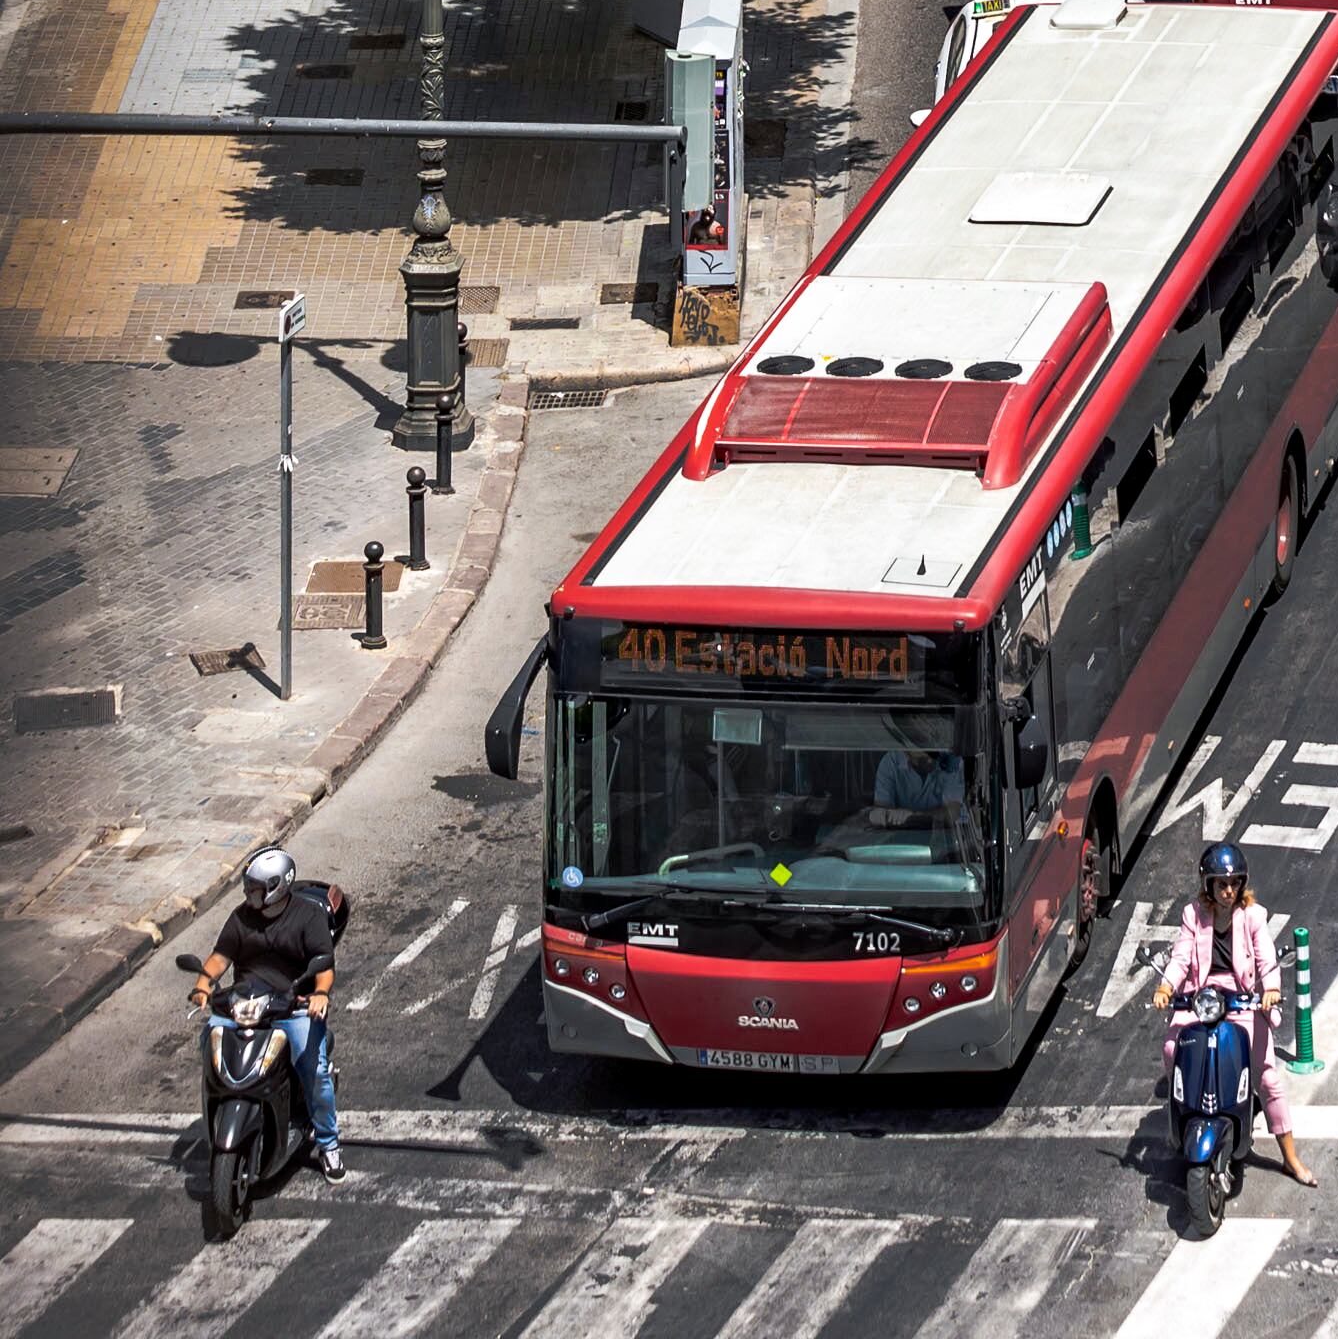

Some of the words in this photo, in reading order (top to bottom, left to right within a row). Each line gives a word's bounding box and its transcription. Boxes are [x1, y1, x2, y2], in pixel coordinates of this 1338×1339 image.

[983, 0, 1002, 12] TAXI
[1019, 546, 1044, 600] EMT
[618, 628, 666, 673] 40
[674, 631, 807, 678] Estació
[826, 636, 908, 681] Nord
[627, 923, 679, 937] EMT
[852, 932, 901, 953] 7102
[737, 1015, 800, 1030] SCANIA
[707, 1051, 754, 1069] 4588
[757, 1053, 792, 1071] GYM
